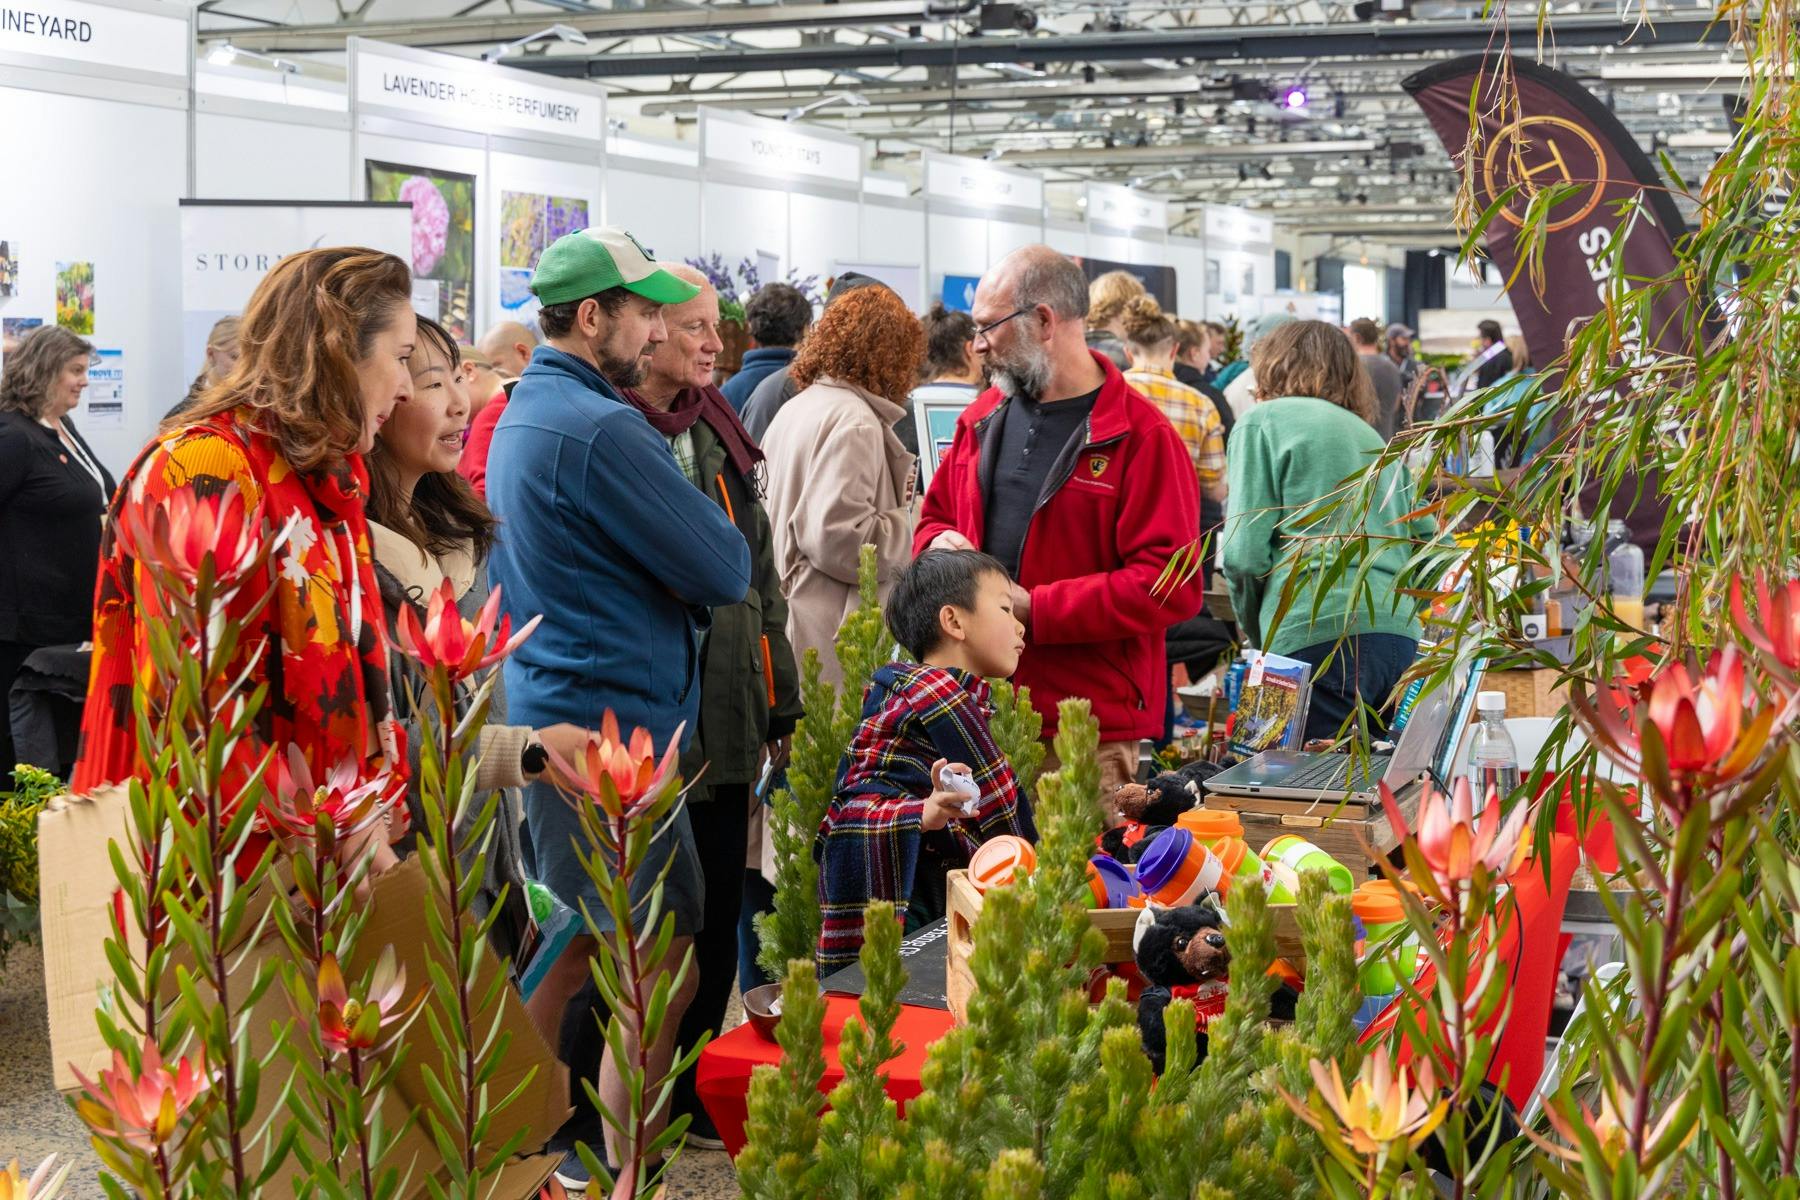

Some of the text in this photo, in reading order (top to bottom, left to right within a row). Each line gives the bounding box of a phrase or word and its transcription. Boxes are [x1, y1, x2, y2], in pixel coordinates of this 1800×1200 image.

[2, 8, 92, 43] INEYARD
[383, 72, 580, 123] LAVENDER HOSE PERFUMERY
[196, 253, 282, 271] STOR
